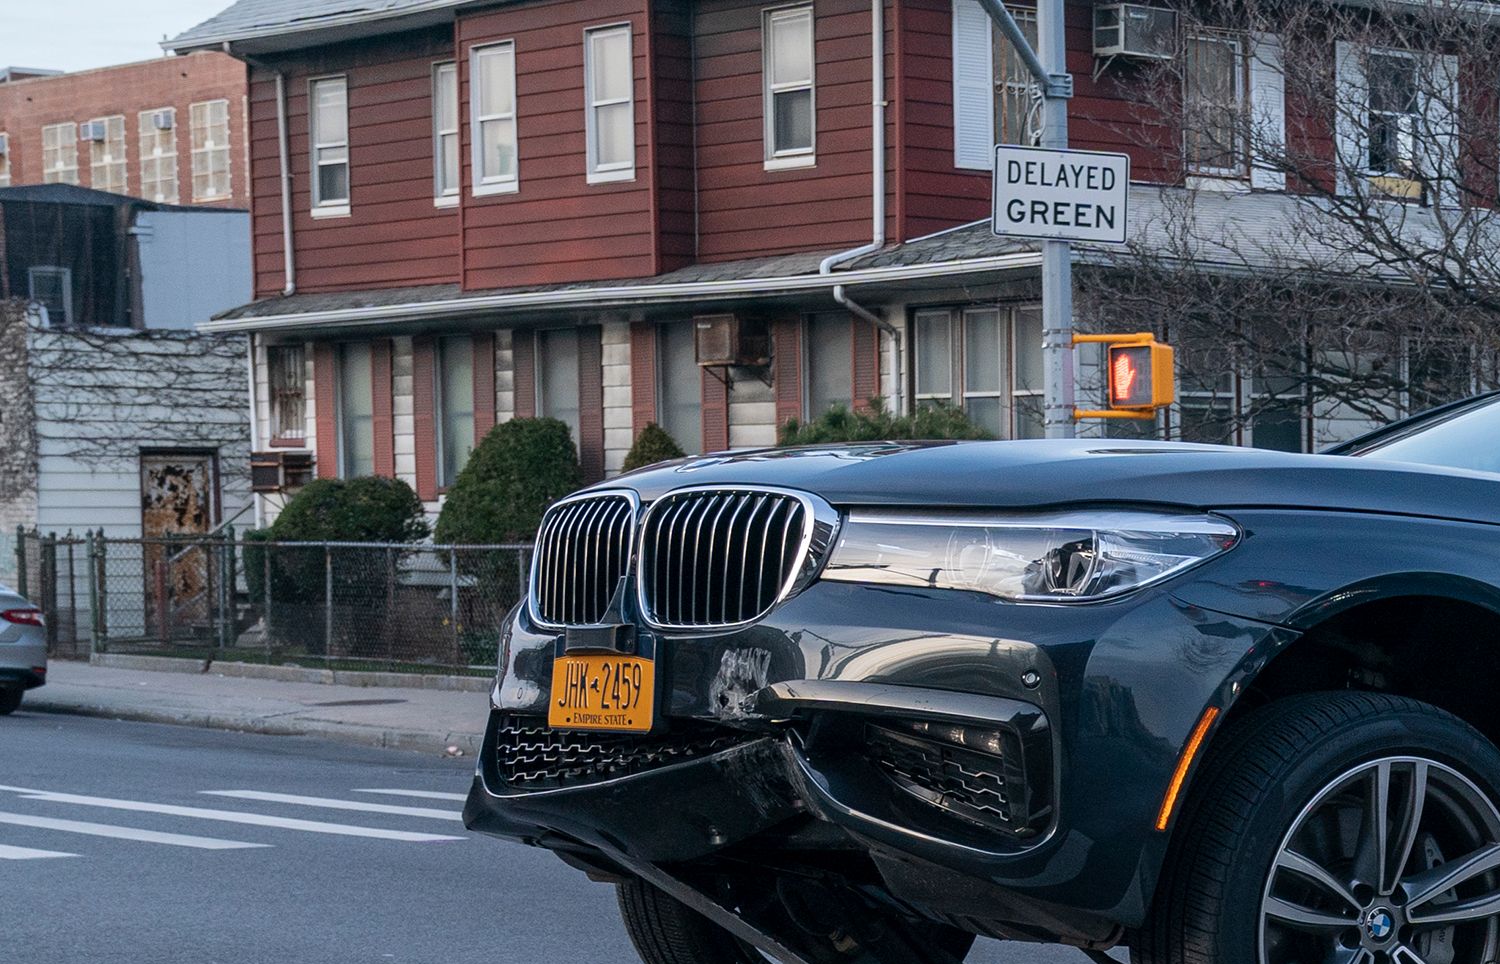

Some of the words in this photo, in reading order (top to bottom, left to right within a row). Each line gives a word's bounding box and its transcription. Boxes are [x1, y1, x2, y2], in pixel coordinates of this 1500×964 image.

[1007, 160, 1115, 191] DELAYED
[1007, 199, 1115, 229] GREEN
[559, 662, 589, 708] JHK
[601, 662, 641, 709] 2459
[573, 712, 602, 725] EMPIRE
[604, 714, 627, 726] STATE
